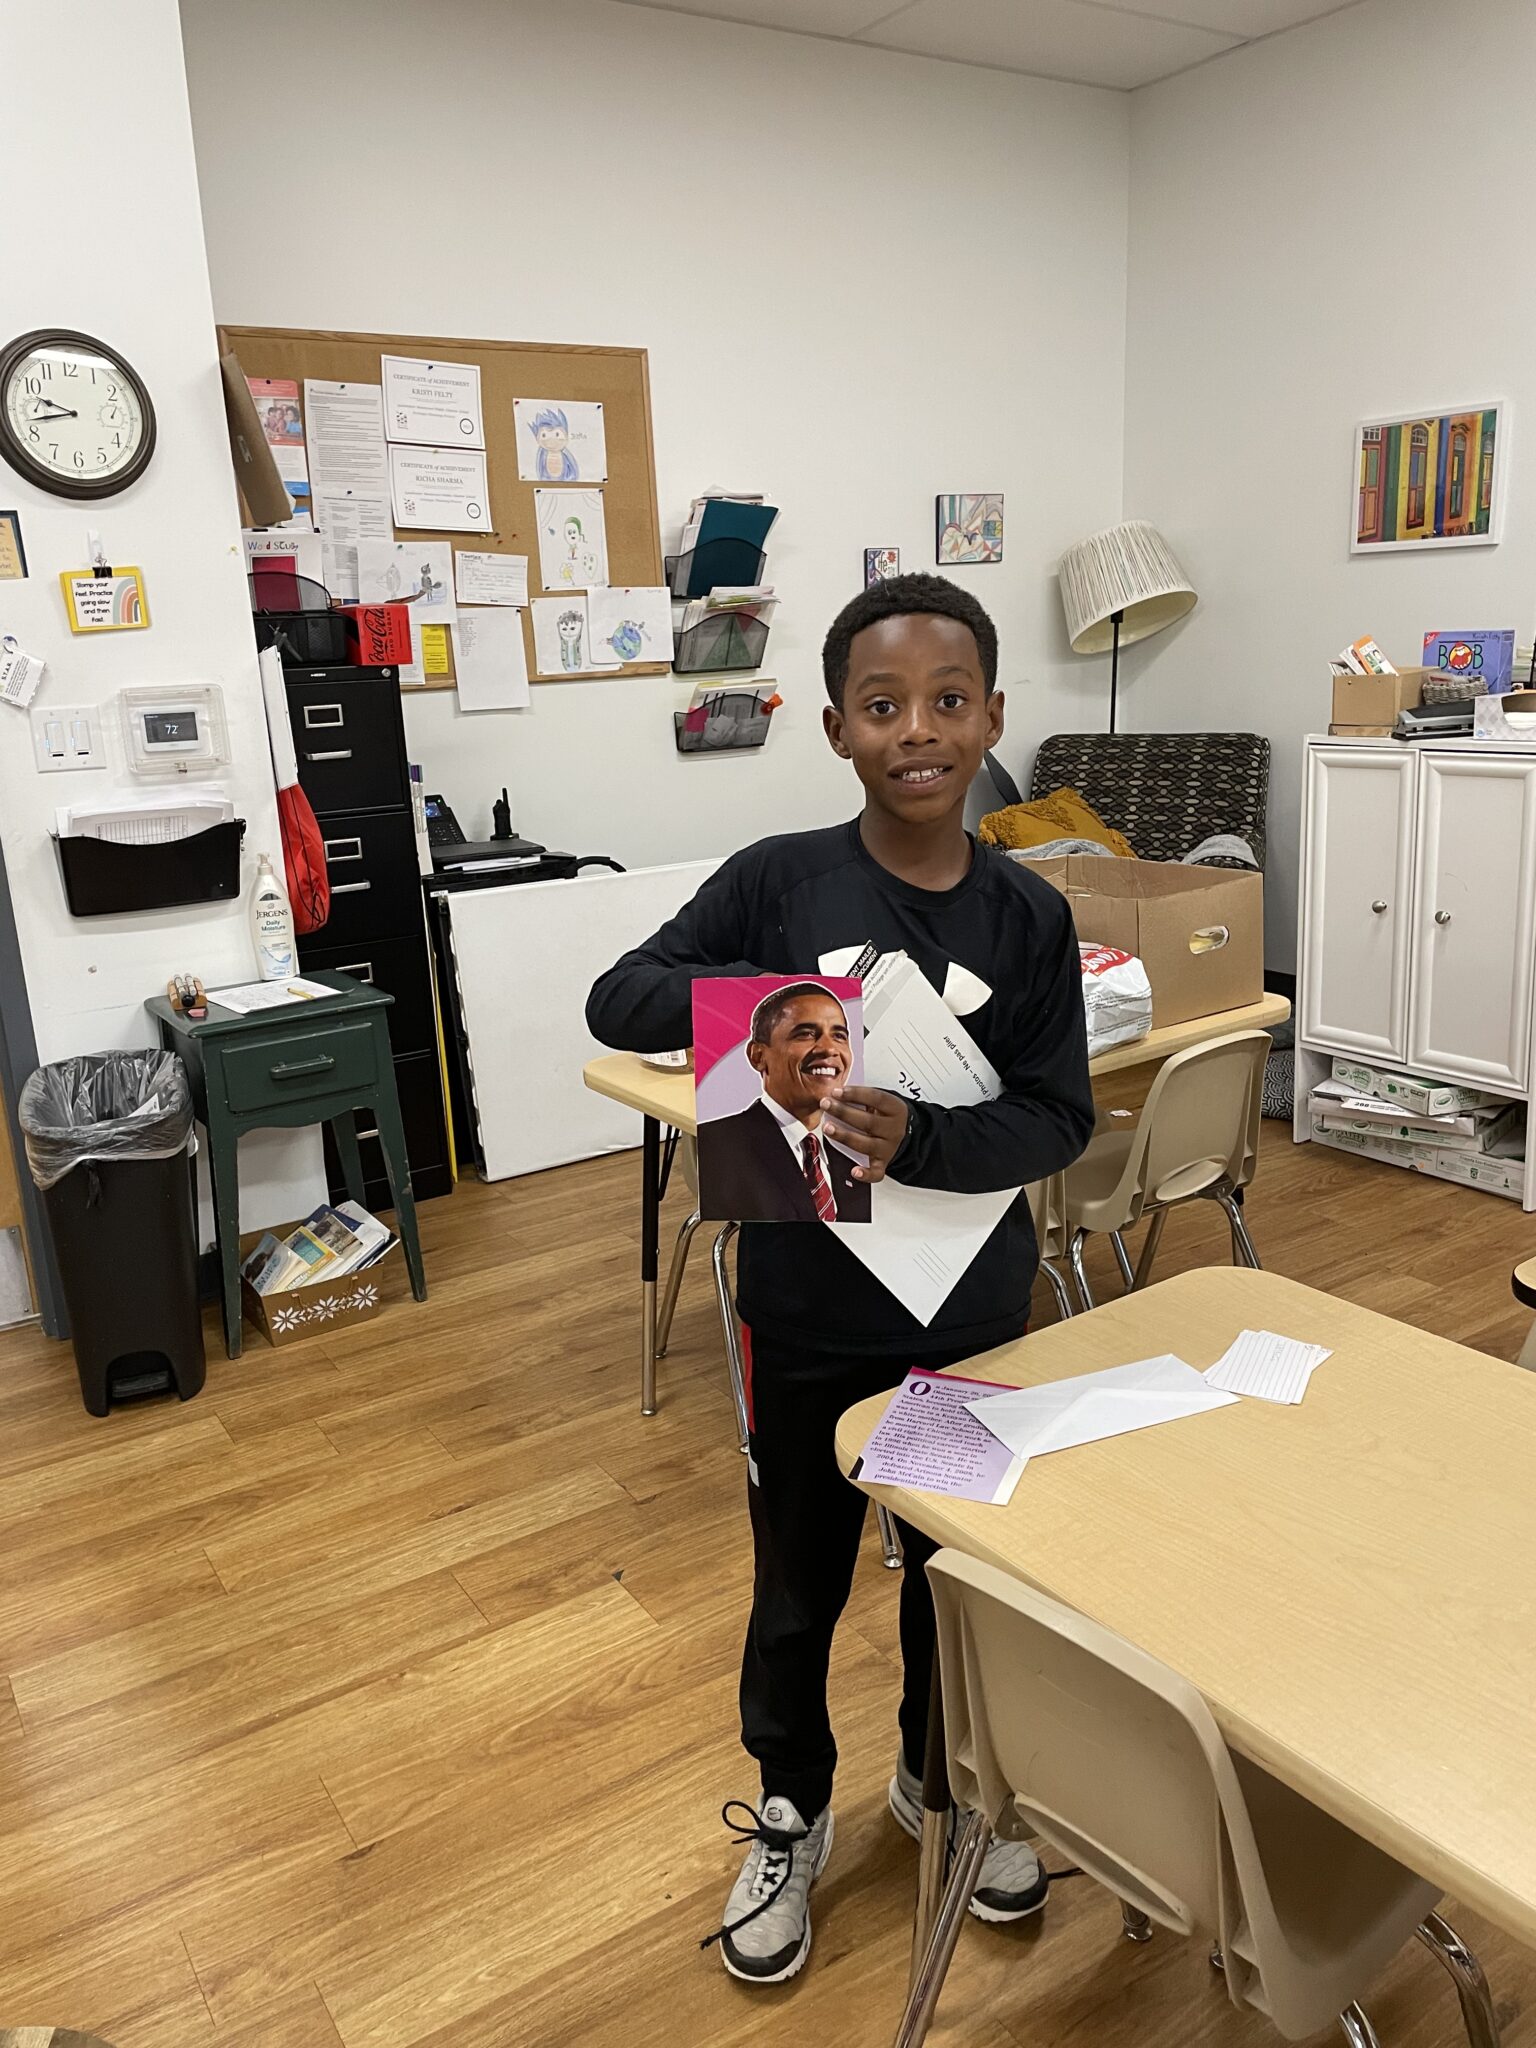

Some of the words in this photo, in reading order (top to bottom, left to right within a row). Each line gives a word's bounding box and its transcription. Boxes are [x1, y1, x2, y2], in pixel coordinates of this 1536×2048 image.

[41, 362, 52, 380] 11
[62, 362, 79, 377] 12
[91, 367, 96, 385] 1
[24, 376, 42, 395] 10
[107, 384, 118, 402] 2
[28, 424, 41, 442] 8
[110, 431, 122, 448] 4
[48, 443, 59, 460] 7
[73, 450, 84, 468] 6
[96, 447, 107, 464] 5
[247, 541, 271, 551] Wod
[1437, 643, 1484, 670] BOB
[165, 724, 179, 735] 72
[256, 908, 288, 920] JERGENS
[859, 945, 875, 967] MAILER
[943, 1035, 957, 1050] plier
[954, 1048, 966, 1062] pas
[962, 1060, 971, 1071] Ne
[972, 1073, 989, 1096] Photos
[909, 1381, 931, 1395] O
[874, 1474, 918, 1485] presidential
